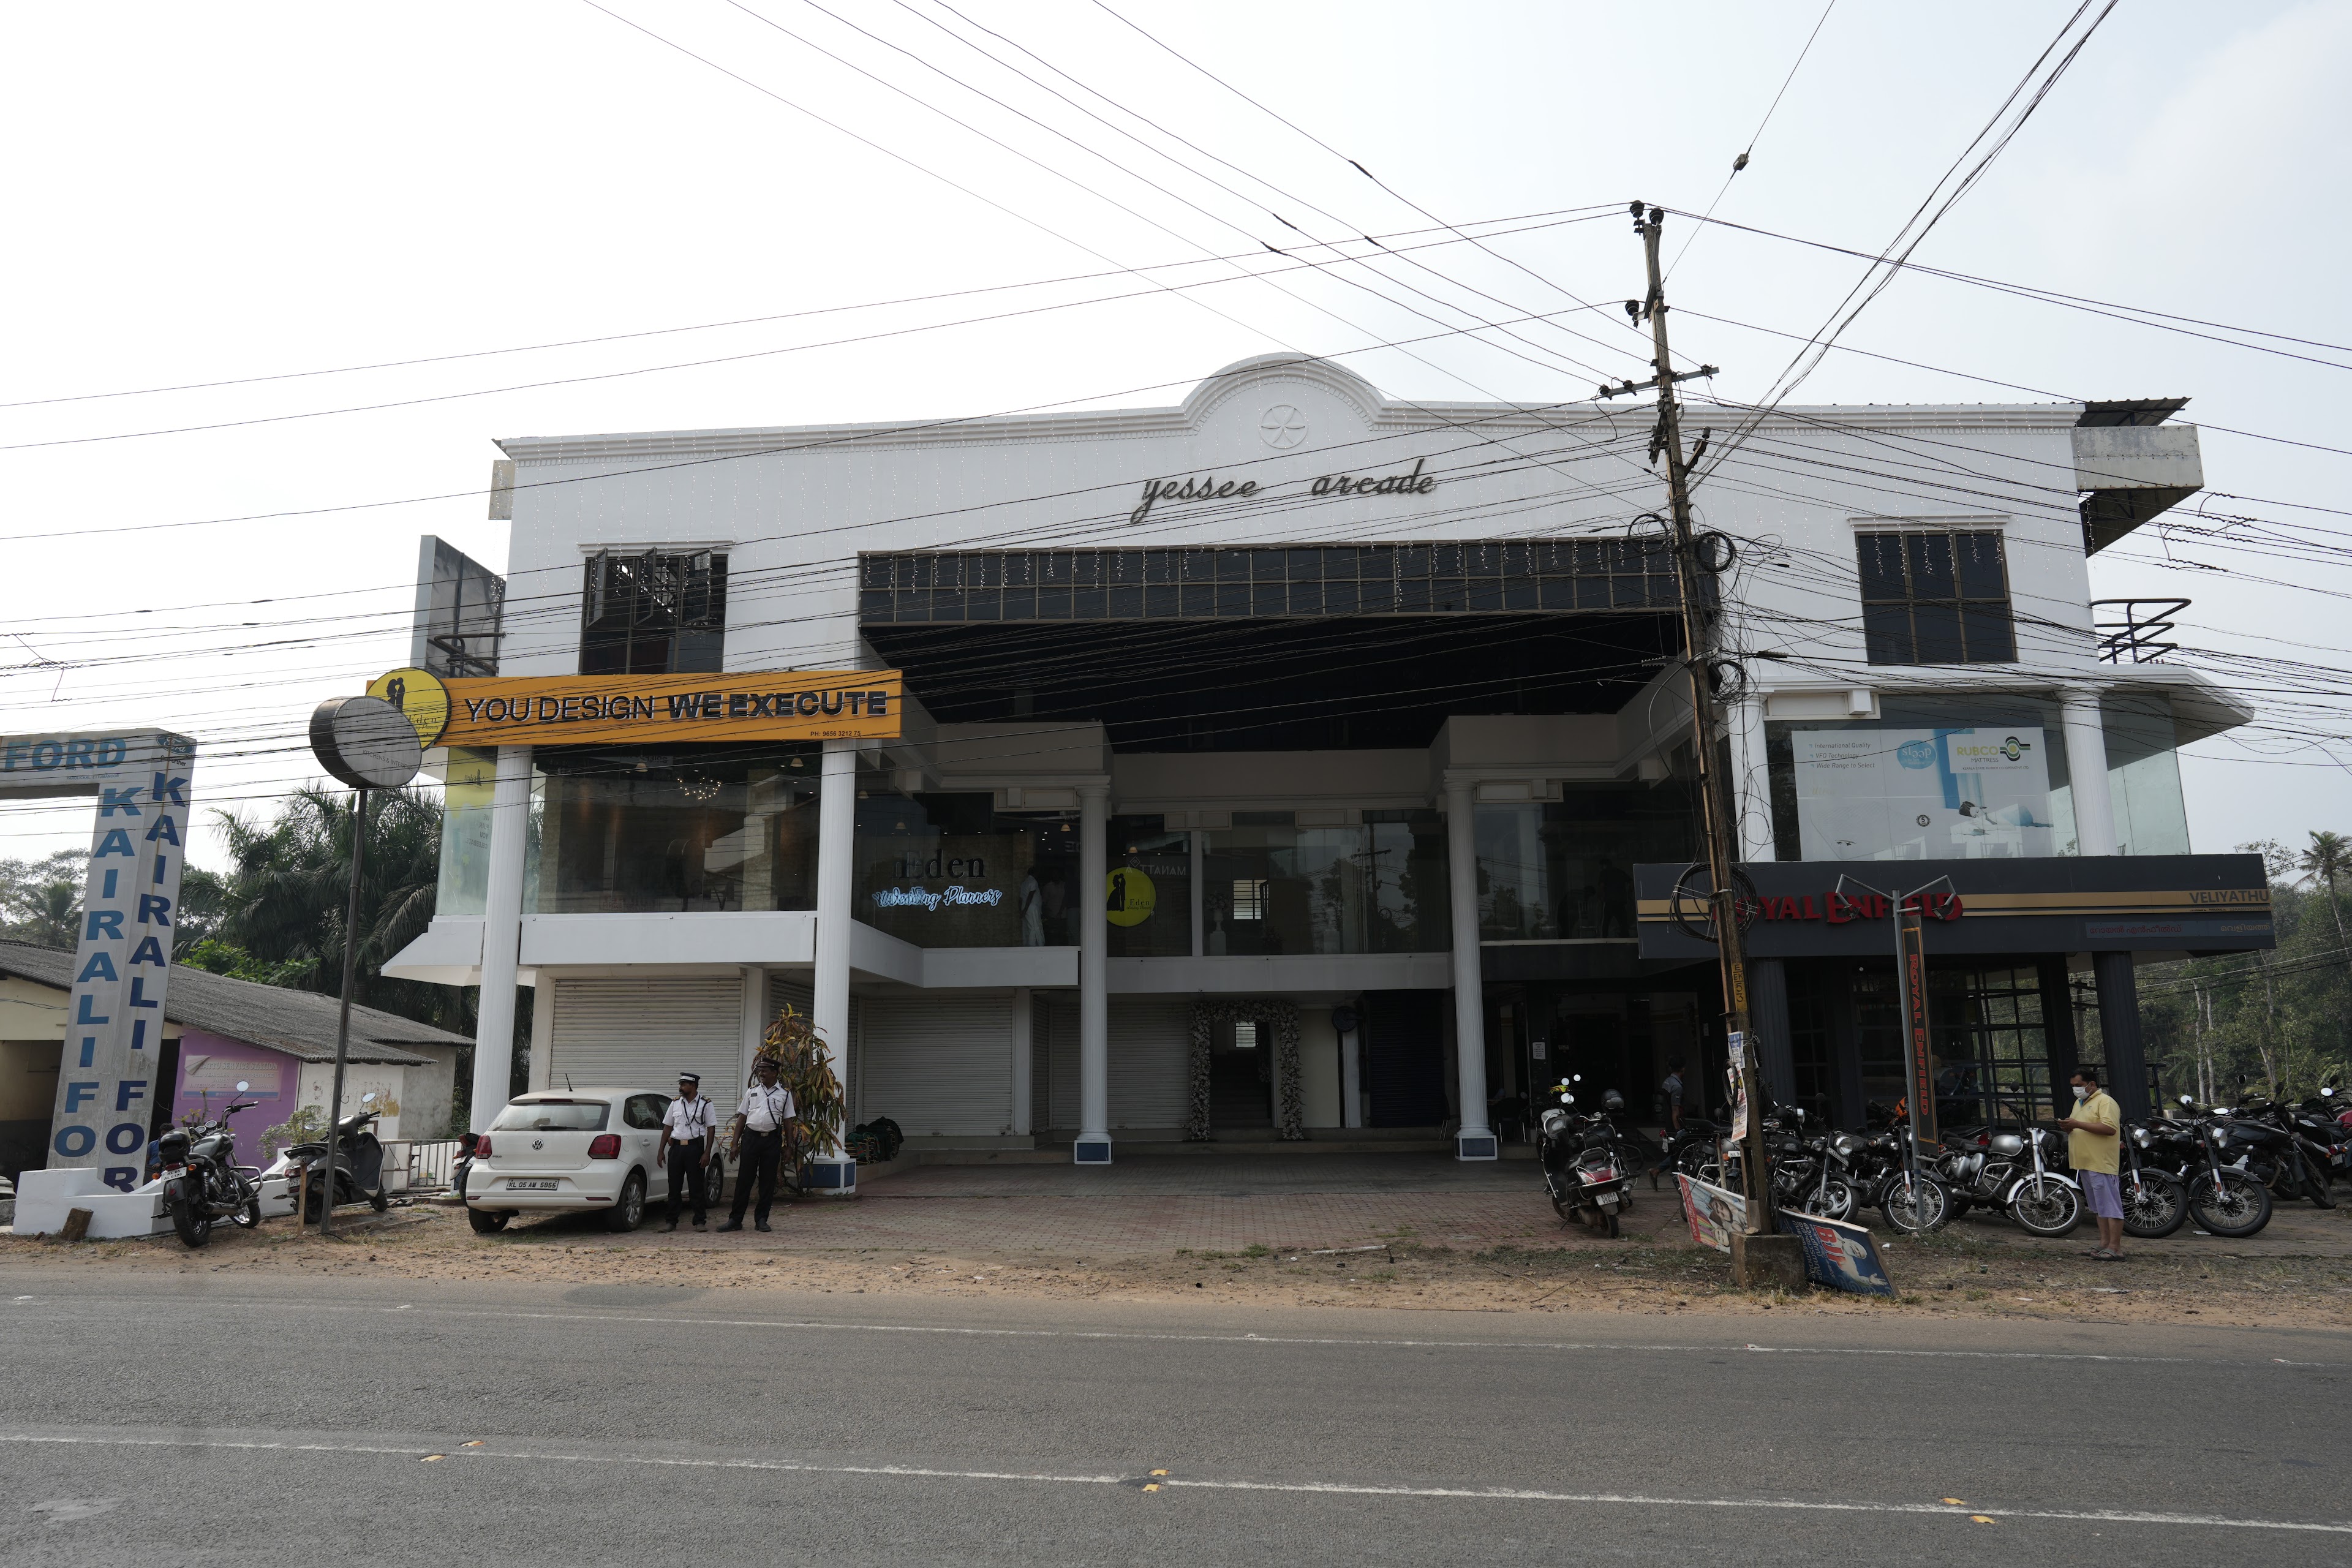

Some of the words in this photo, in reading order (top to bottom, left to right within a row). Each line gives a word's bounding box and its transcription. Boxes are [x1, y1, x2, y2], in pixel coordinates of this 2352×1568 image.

[1130, 476, 1264, 524] yessee
[1311, 458, 1438, 496] arcade
[464, 697, 532, 723] YOU
[538, 695, 655, 722] DESIGN
[668, 694, 723, 719] WE
[729, 691, 888, 718] EXECUTE
[409, 714, 437, 724] Eden
[4, 737, 126, 772] FORD
[363, 750, 385, 762] KITCHENS
[1956, 746, 1999, 756] RUBCO
[943, 886, 1003, 907] Planners
[1713, 895, 1822, 921] OYAL
[2189, 890, 2270, 903] VELIYATHU
[1909, 953, 1922, 1023] ROYAL
[251, 1061, 278, 1070] STATION
[1914, 1027, 1929, 1116] ENFIELD
